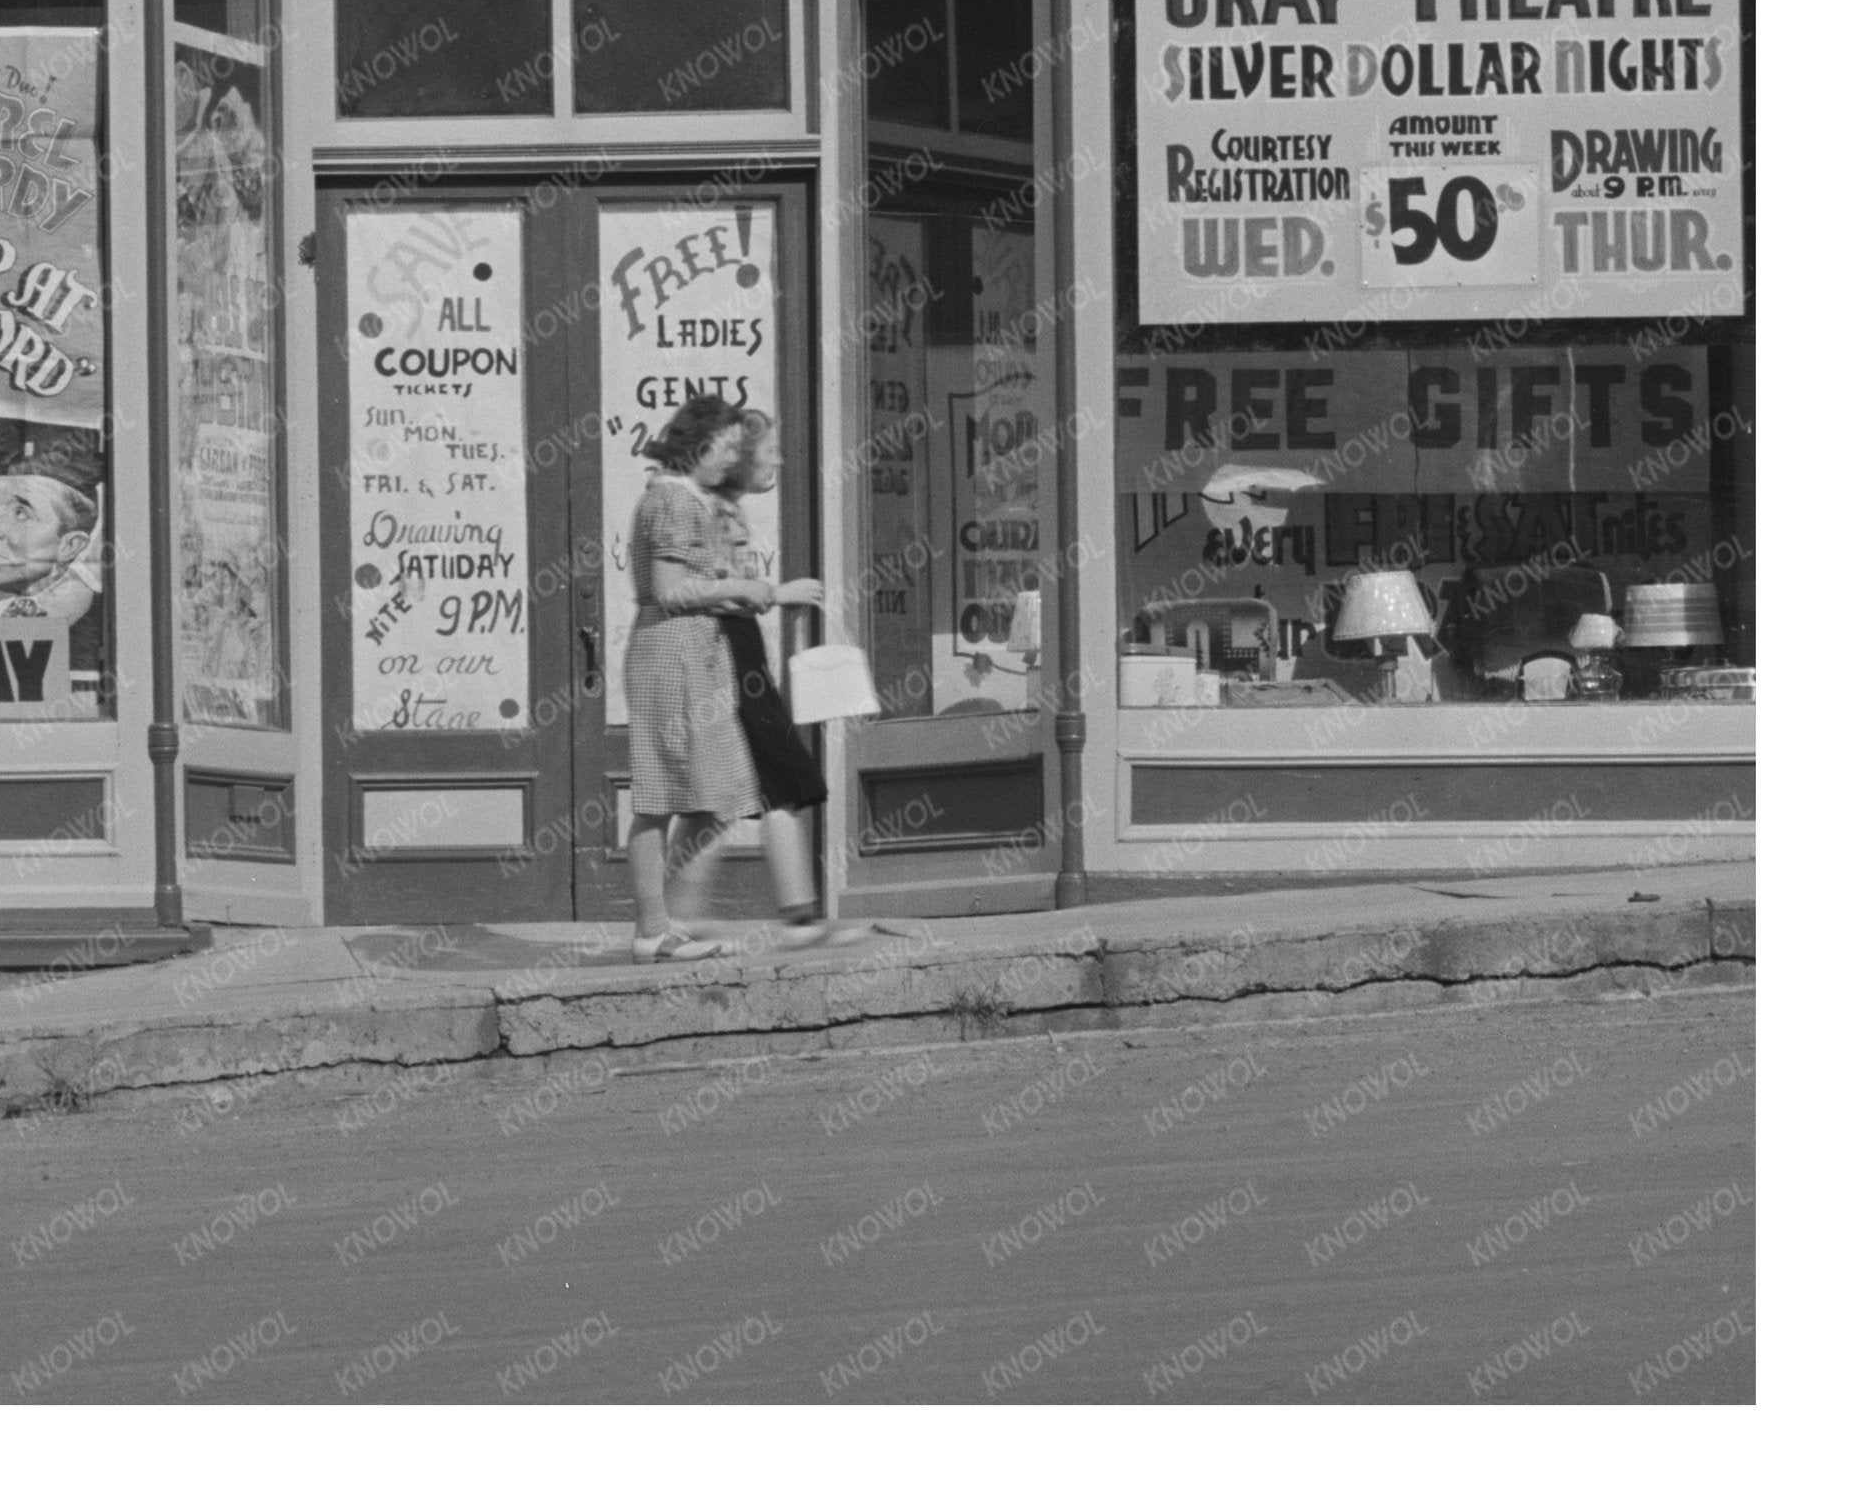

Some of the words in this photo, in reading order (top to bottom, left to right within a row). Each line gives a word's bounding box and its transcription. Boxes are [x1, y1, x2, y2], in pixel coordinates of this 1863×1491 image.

[1161, 40, 1336, 103] SILVER
[1345, 41, 1543, 97] DOLLAR
[1553, 35, 1723, 94] NIGHTS
[1388, 114, 1499, 136] AMOUNT
[1210, 127, 1334, 164] COURTESY
[1388, 141, 1437, 158] THIS
[1441, 138, 1502, 157] WEEK
[1549, 126, 1723, 194] DRAWING
[1165, 143, 1350, 204] REGISTRATION
[1603, 175, 1626, 200] 9
[1182, 215, 1335, 278] WED.
[1553, 207, 1734, 273] THUR.
[366, 212, 491, 341] SAVE
[3, 261, 100, 336] AT
[437, 296, 492, 333] ALL
[655, 316, 764, 357] LADIES
[373, 346, 519, 378] COUPON
[392, 383, 474, 398] TICKETS
[635, 375, 750, 412] GENTS
[1116, 366, 1337, 451] FREE
[1408, 364, 1694, 450] GIFTS
[403, 424, 464, 443] MON.
[445, 443, 507, 462] TUES.
[362, 474, 410, 495] FRI.
[445, 472, 497, 495] SAT.
[363, 509, 503, 567] Drawing
[1203, 514, 1316, 576] every
[435, 594, 463, 637] 9
[377, 651, 424, 677] on
[436, 651, 501, 677] our
